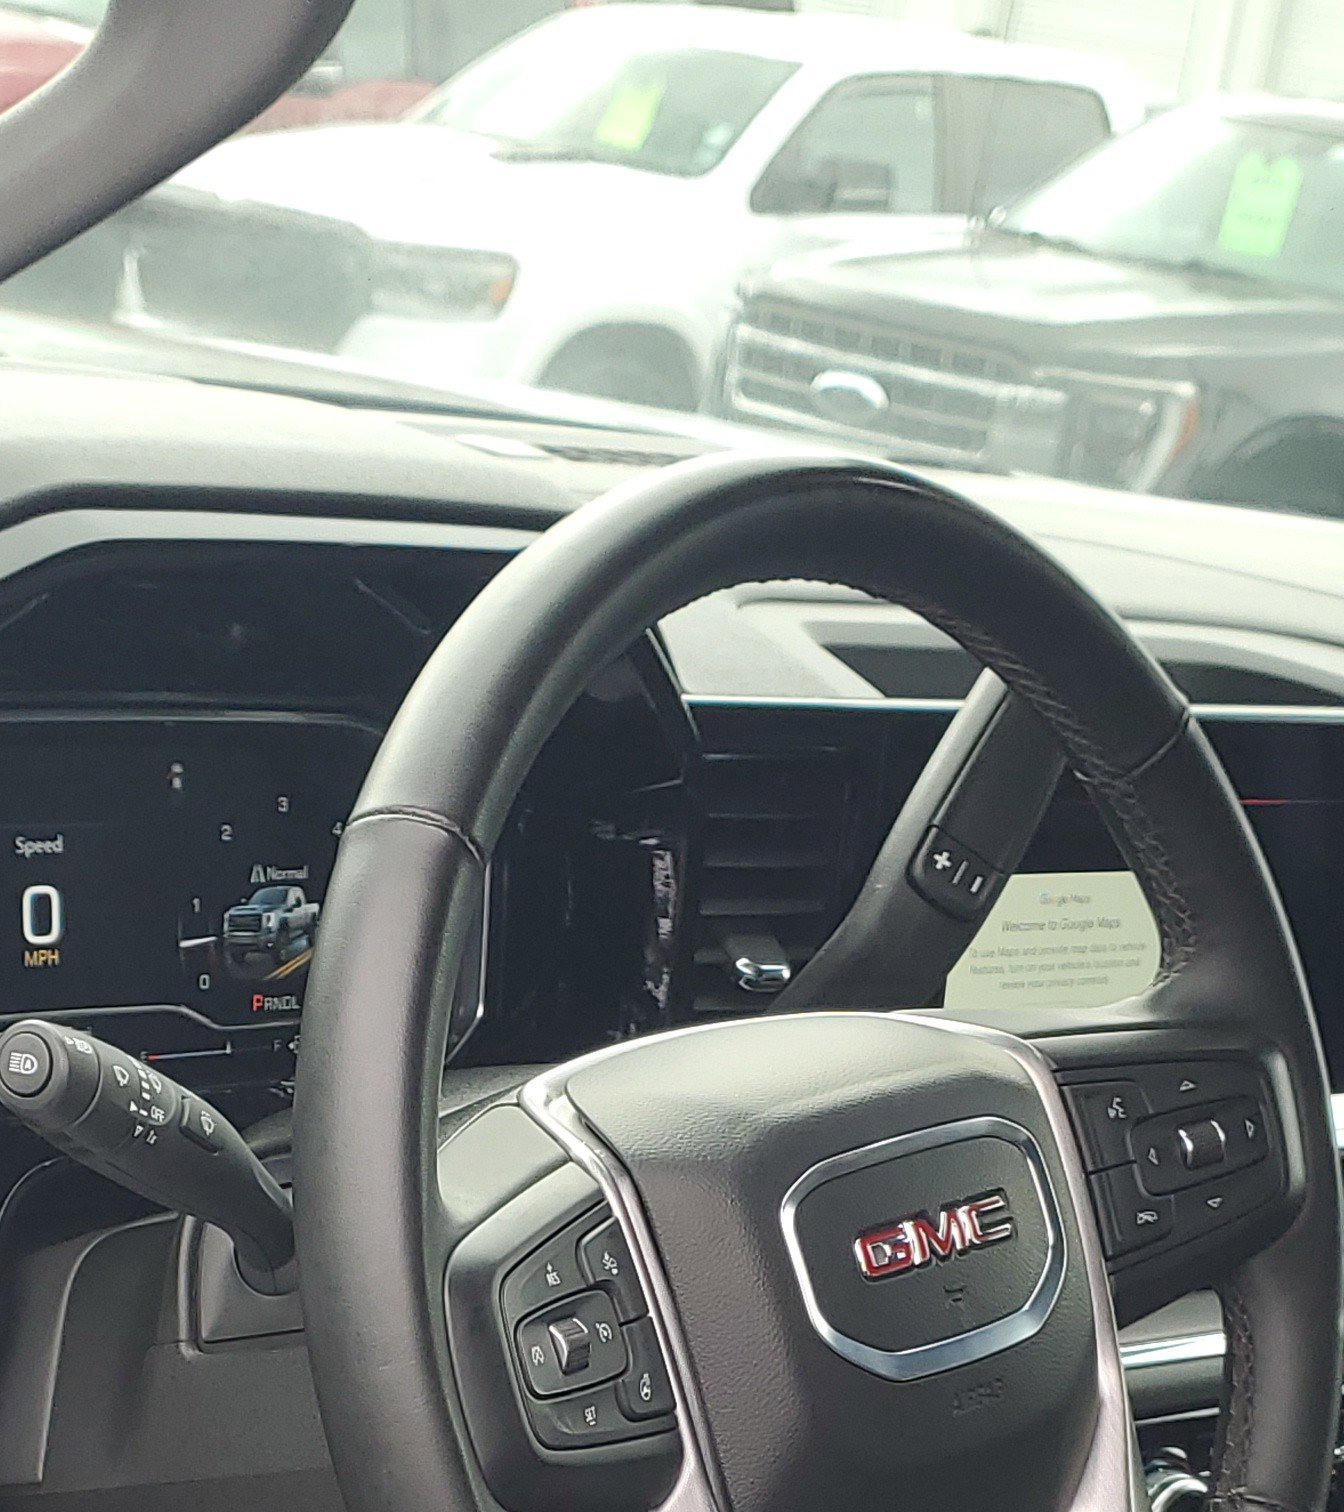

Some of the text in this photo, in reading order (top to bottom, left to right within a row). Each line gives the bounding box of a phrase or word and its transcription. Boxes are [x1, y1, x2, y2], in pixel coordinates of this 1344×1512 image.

[276, 795, 290, 814] 3
[219, 823, 234, 842] 2
[14, 833, 64, 858] Speed
[265, 864, 309, 880] Normal
[191, 896, 202, 913] 1
[21, 884, 62, 945] 0
[23, 948, 60, 967] MPH
[198, 973, 212, 991] 0
[853, 1190, 1016, 1283] GMC
